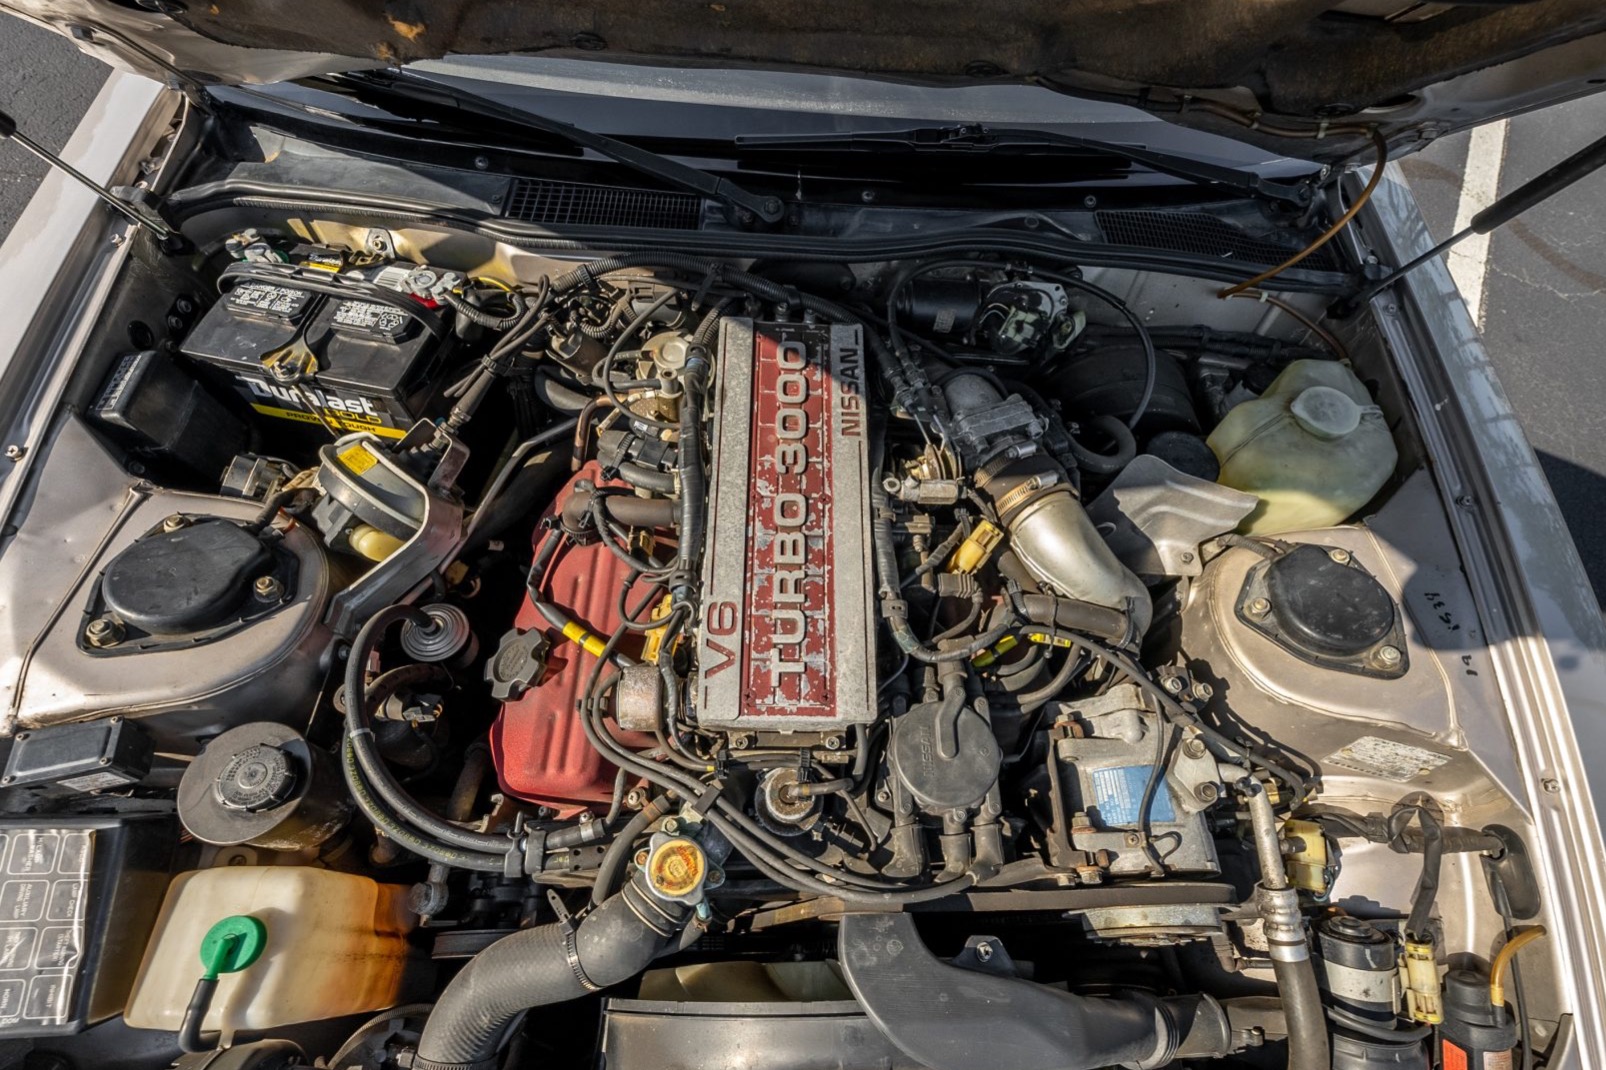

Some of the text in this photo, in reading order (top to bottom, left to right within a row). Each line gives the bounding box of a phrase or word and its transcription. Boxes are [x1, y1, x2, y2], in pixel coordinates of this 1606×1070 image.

[839, 347, 861, 437] NISSAN
[770, 341, 808, 687] TURBO 3000
[704, 601, 738, 679] V6
[20, 883, 33, 917] AUXILIARY
